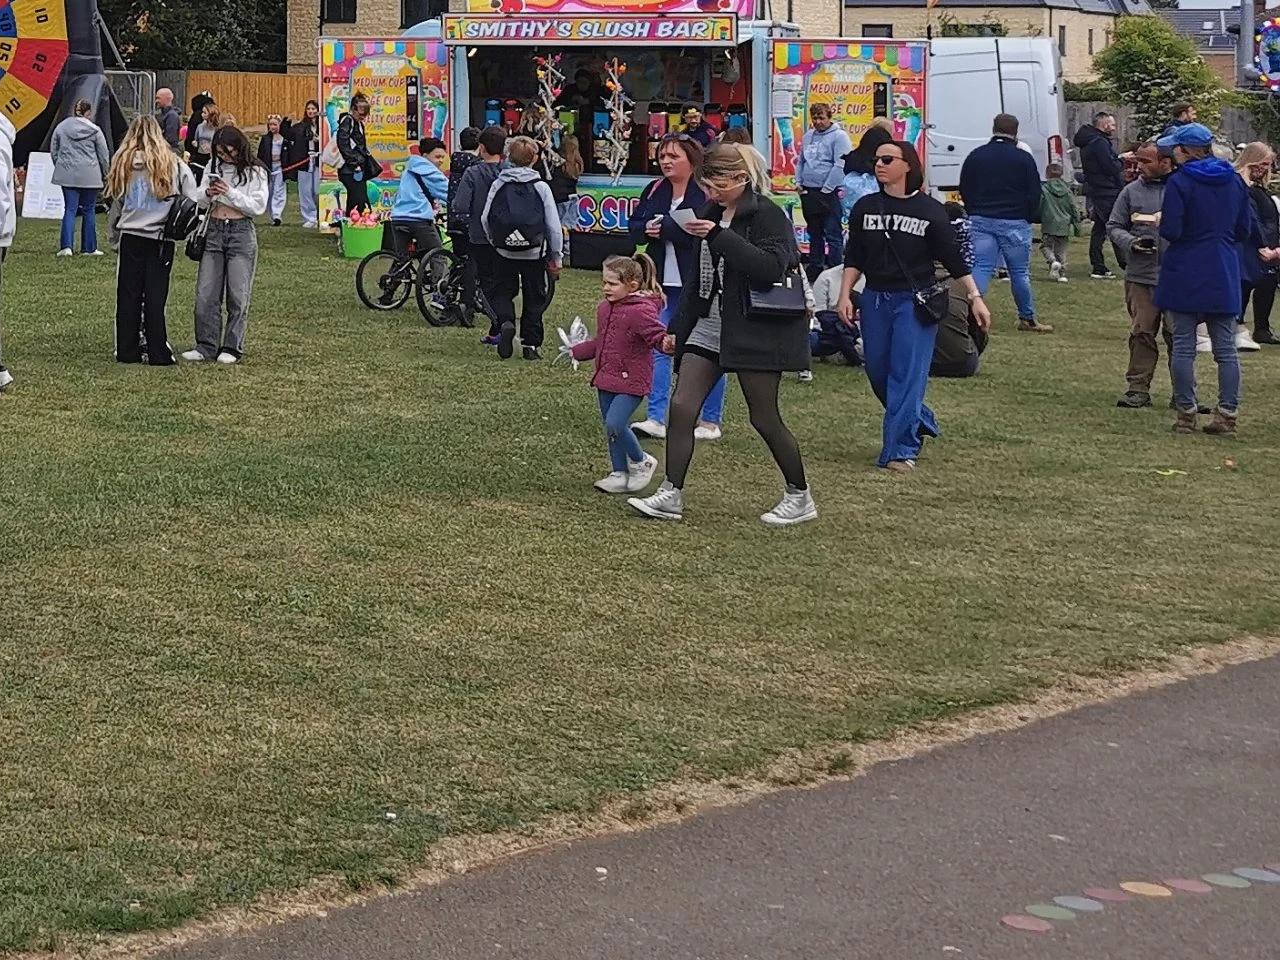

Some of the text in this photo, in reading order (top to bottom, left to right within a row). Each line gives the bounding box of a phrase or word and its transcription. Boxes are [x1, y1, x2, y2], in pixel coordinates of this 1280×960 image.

[0, 12, 13, 32] 40
[35, 8, 49, 23] 10
[465, 19, 710, 39] SMITHY'S SLUSH BAR
[32, 53, 48, 73] 20
[353, 76, 386, 88] MEDIUM
[388, 77, 405, 88] CUP
[810, 83, 849, 95] MEDIUM
[852, 84, 872, 95] CUP
[5, 97, 21, 114] 10
[384, 95, 402, 106] CUP
[846, 103, 868, 115] CUP
[849, 123, 868, 134] CUP
[892, 214, 930, 237] YORK
